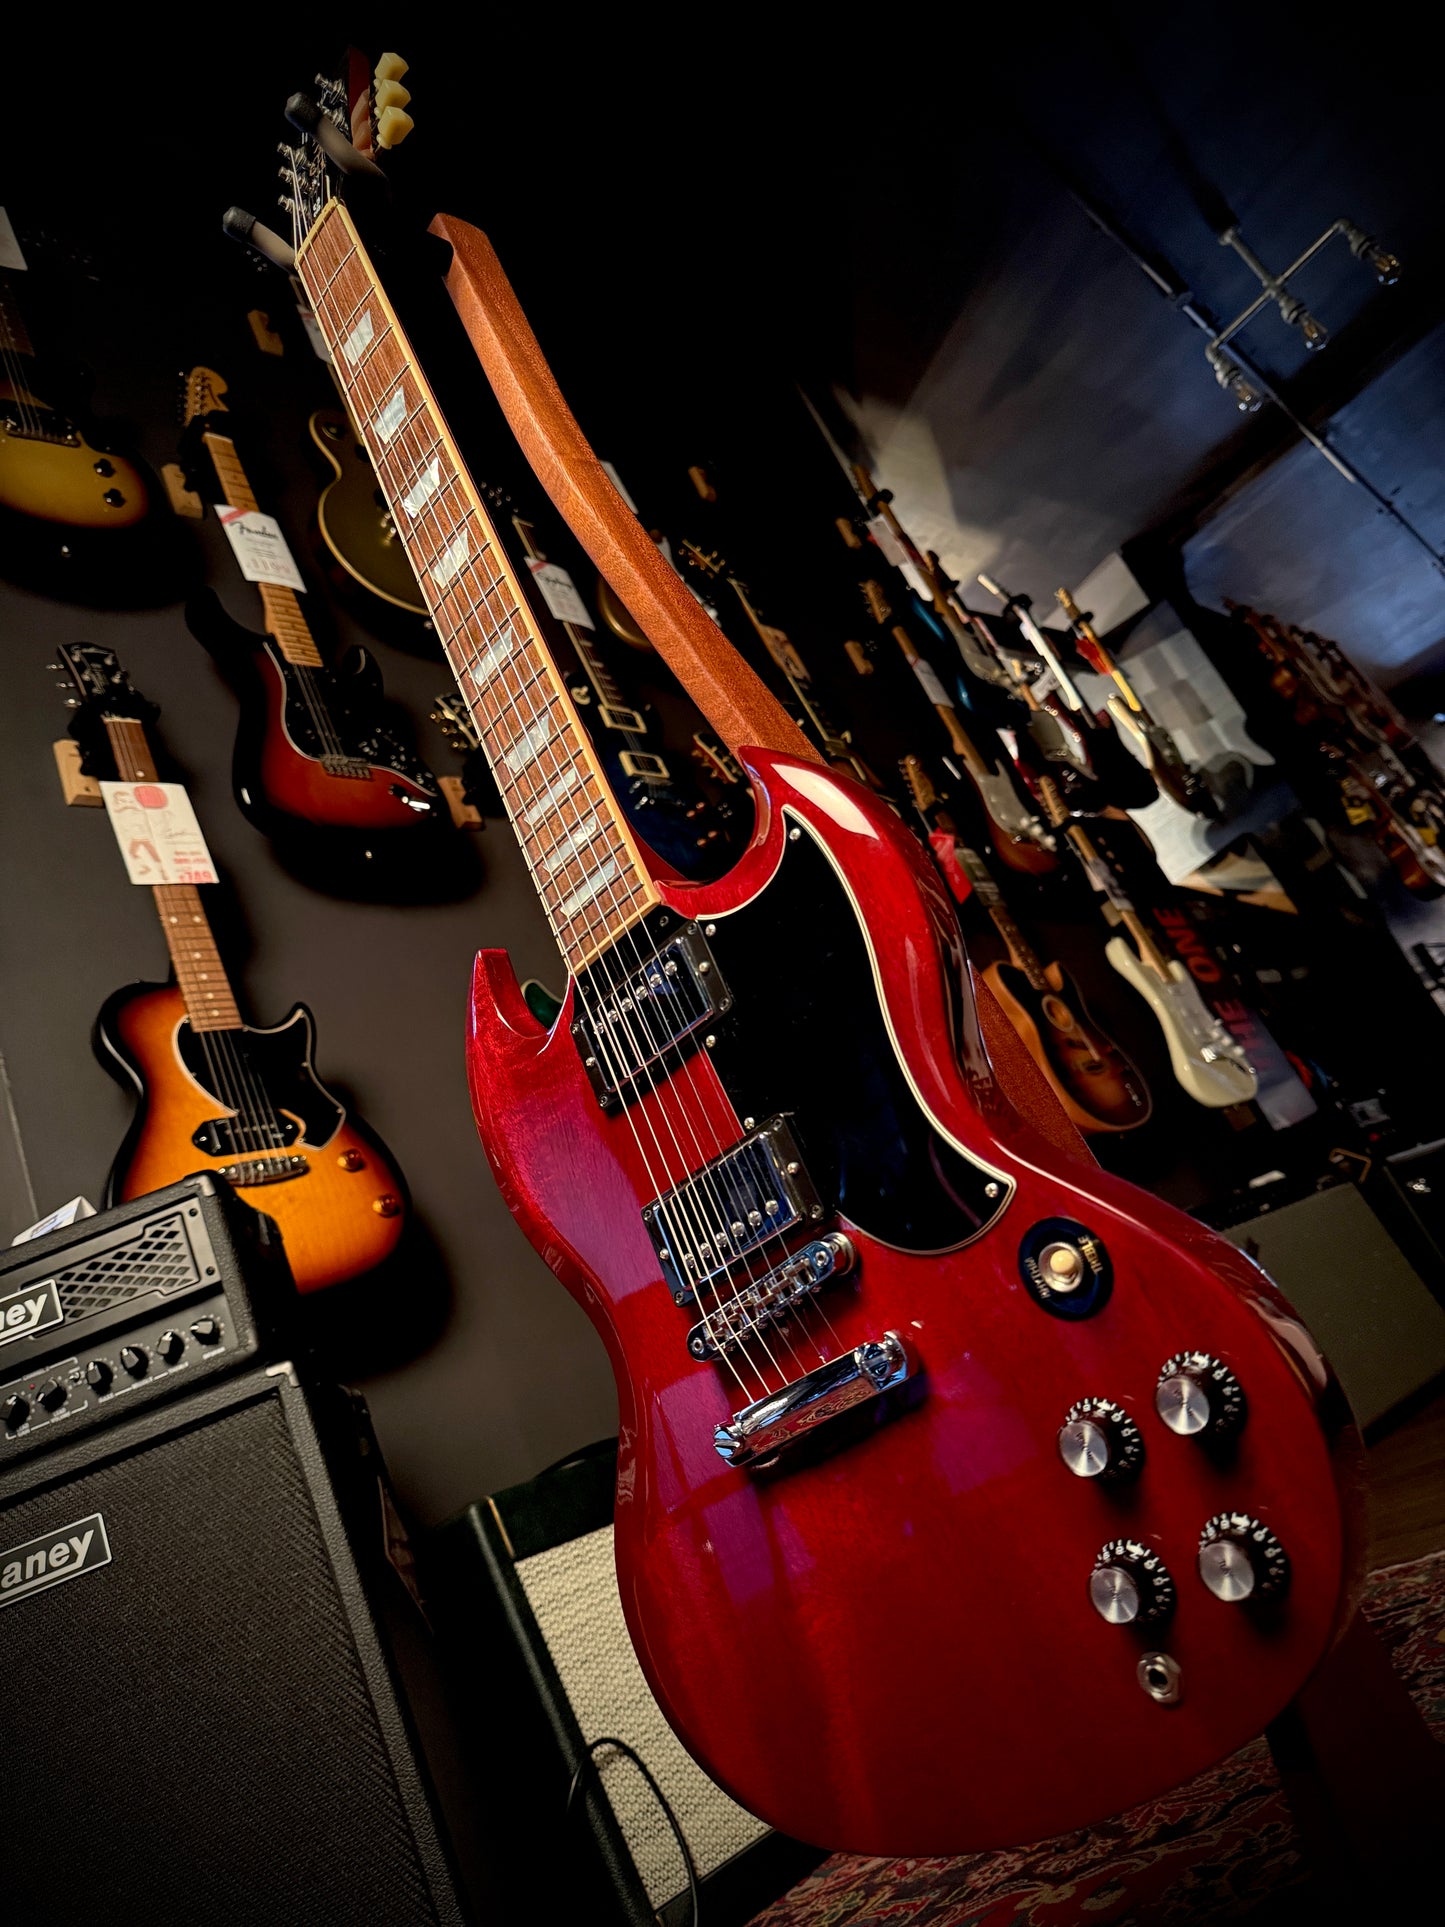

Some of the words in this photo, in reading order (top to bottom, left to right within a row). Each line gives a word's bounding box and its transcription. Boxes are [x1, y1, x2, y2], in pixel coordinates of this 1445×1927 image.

[1152, 906, 1222, 984] ONE
[1077, 1234, 1104, 1275] TREBLE
[0, 1293, 48, 1334] ey
